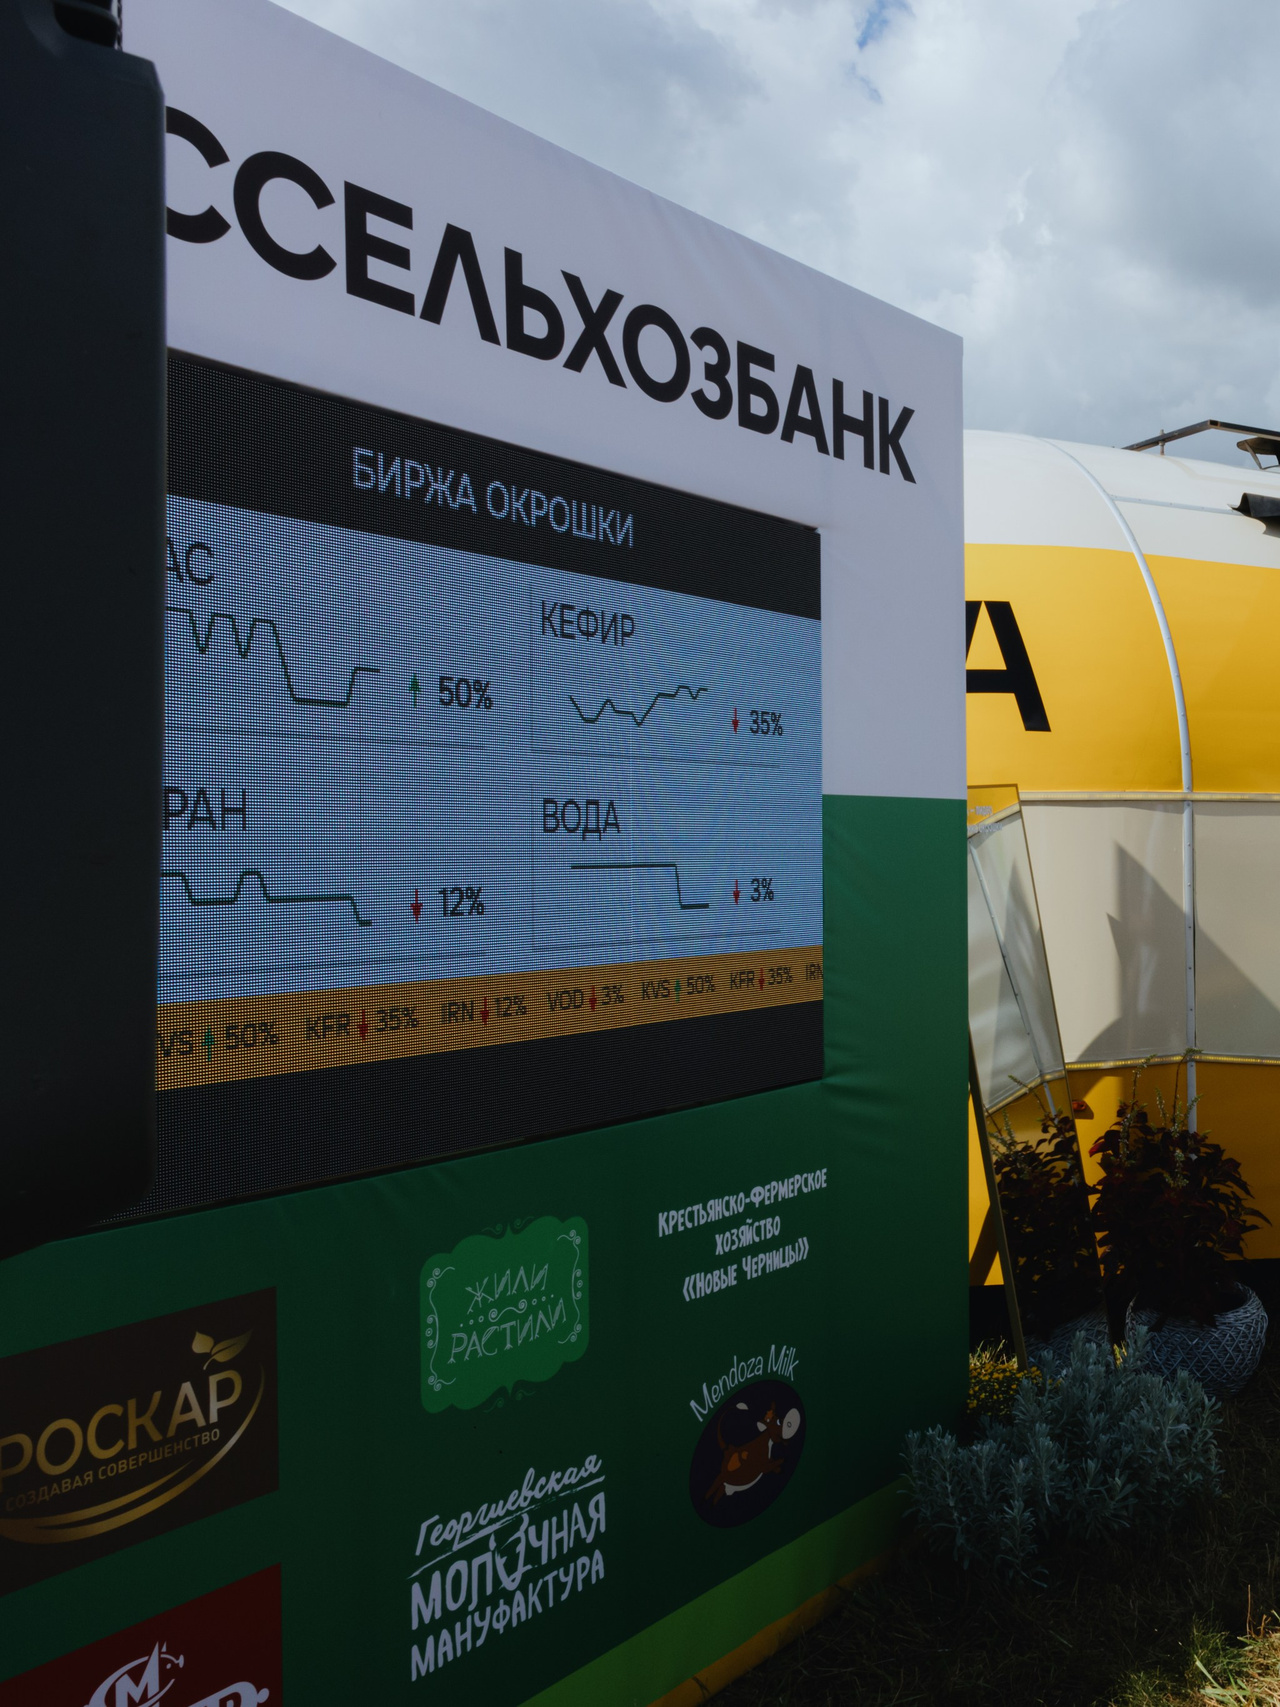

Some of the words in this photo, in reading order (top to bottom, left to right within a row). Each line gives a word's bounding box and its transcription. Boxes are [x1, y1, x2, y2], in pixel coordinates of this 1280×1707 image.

[353, 446, 477, 513] БИРЖА
[486, 480, 634, 548] ОКРОШКИ
[542, 600, 635, 646] КЕФИР
[438, 676, 493, 710] 50%
[749, 709, 783, 736] 35%
[542, 798, 621, 841] ВОДА
[438, 886, 485, 917] 12%
[750, 877, 775, 902] 3%
[224, 1020, 280, 1050] 50%
[305, 1012, 351, 1041] KFR
[376, 1006, 419, 1032] 35%
[441, 999, 474, 1025] IRN
[495, 994, 528, 1018] 12%
[546, 988, 584, 1011] VOD
[601, 984, 625, 1006] 3%
[642, 979, 671, 1001] KVS
[687, 974, 716, 996] 50%
[730, 970, 755, 990] KFR
[768, 966, 793, 986] 35%
[658, 1168, 828, 1238] КРЕСТЬЯНСКО-ФЕРМЕРСКОЕ
[715, 1215, 781, 1256] ХОЗЯЙСТВО
[465, 1263, 548, 1315] ЖИЛИ
[447, 1297, 566, 1364] РАСТИЛИ
[689, 1355, 764, 1422] Mendoza
[768, 1344, 799, 1381] Milk
[0, 1370, 243, 1493] РОСКАР
[5, 1470, 93, 1512] СОЗДАВАЯ
[98, 1428, 220, 1480] СОВЕРШЕНСТВО
[415, 1454, 603, 1556] Георгиевская
[411, 1549, 605, 1682] МАНУФАКТУРА
